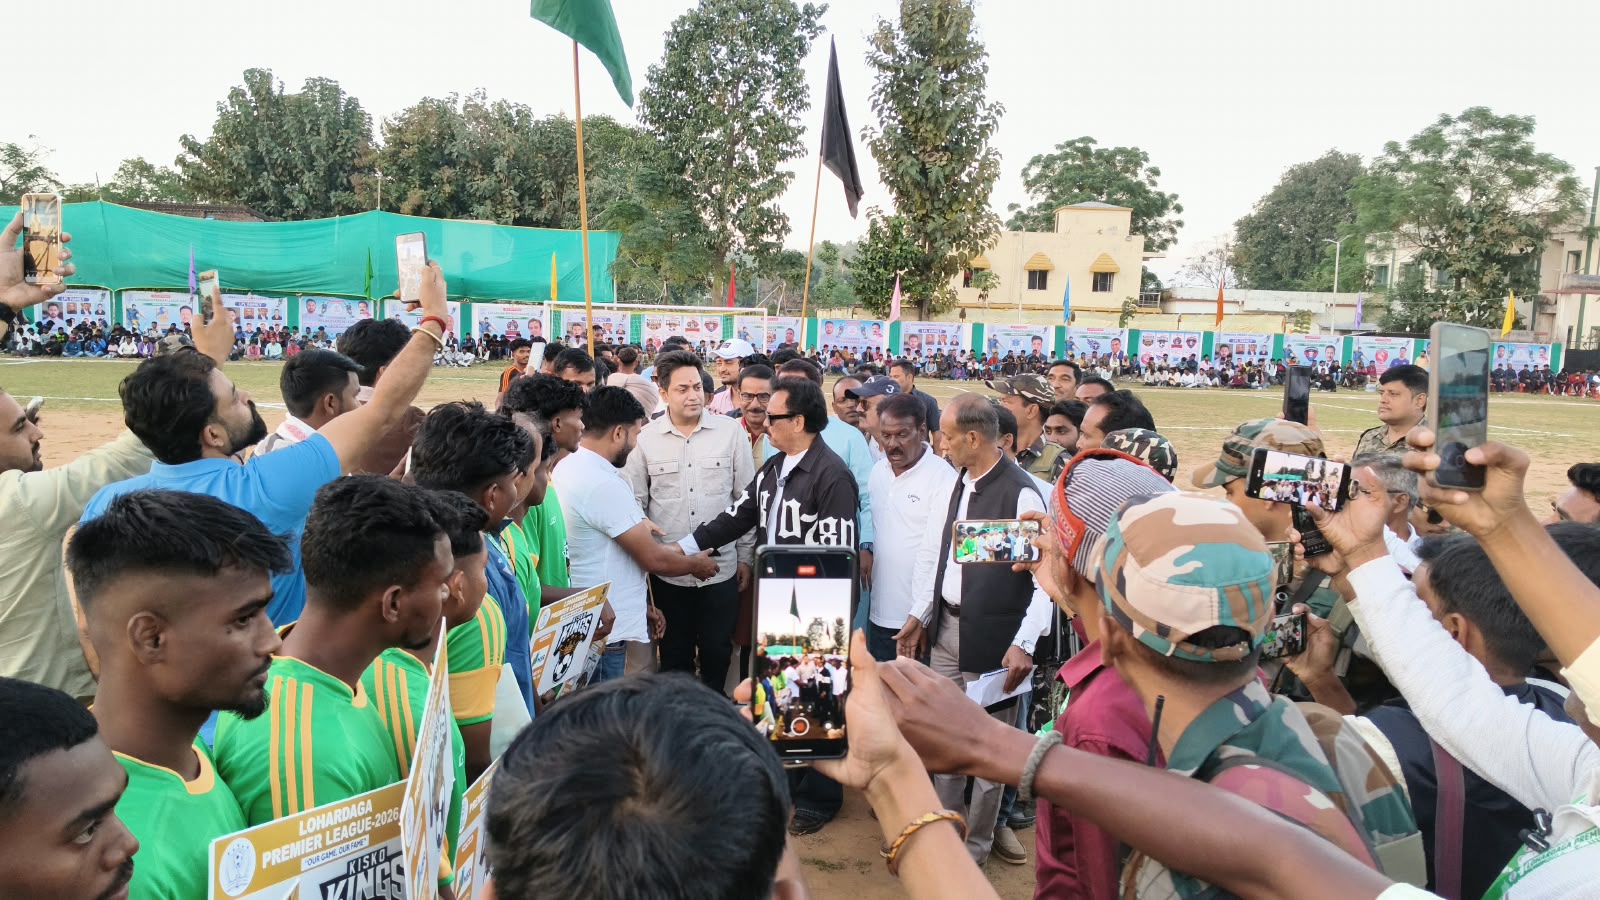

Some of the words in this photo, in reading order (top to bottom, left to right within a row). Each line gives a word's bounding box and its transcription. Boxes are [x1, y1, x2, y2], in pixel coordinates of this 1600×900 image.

[885, 384, 895, 394] 3
[299, 799, 373, 837] LOHARDAGA
[262, 837, 322, 869] PREMIER
[326, 807, 400, 846] LEAGUE-2026
[338, 843, 350, 855] OUR
[326, 854, 406, 900] KINGS
[349, 848, 386, 876] KISKO
